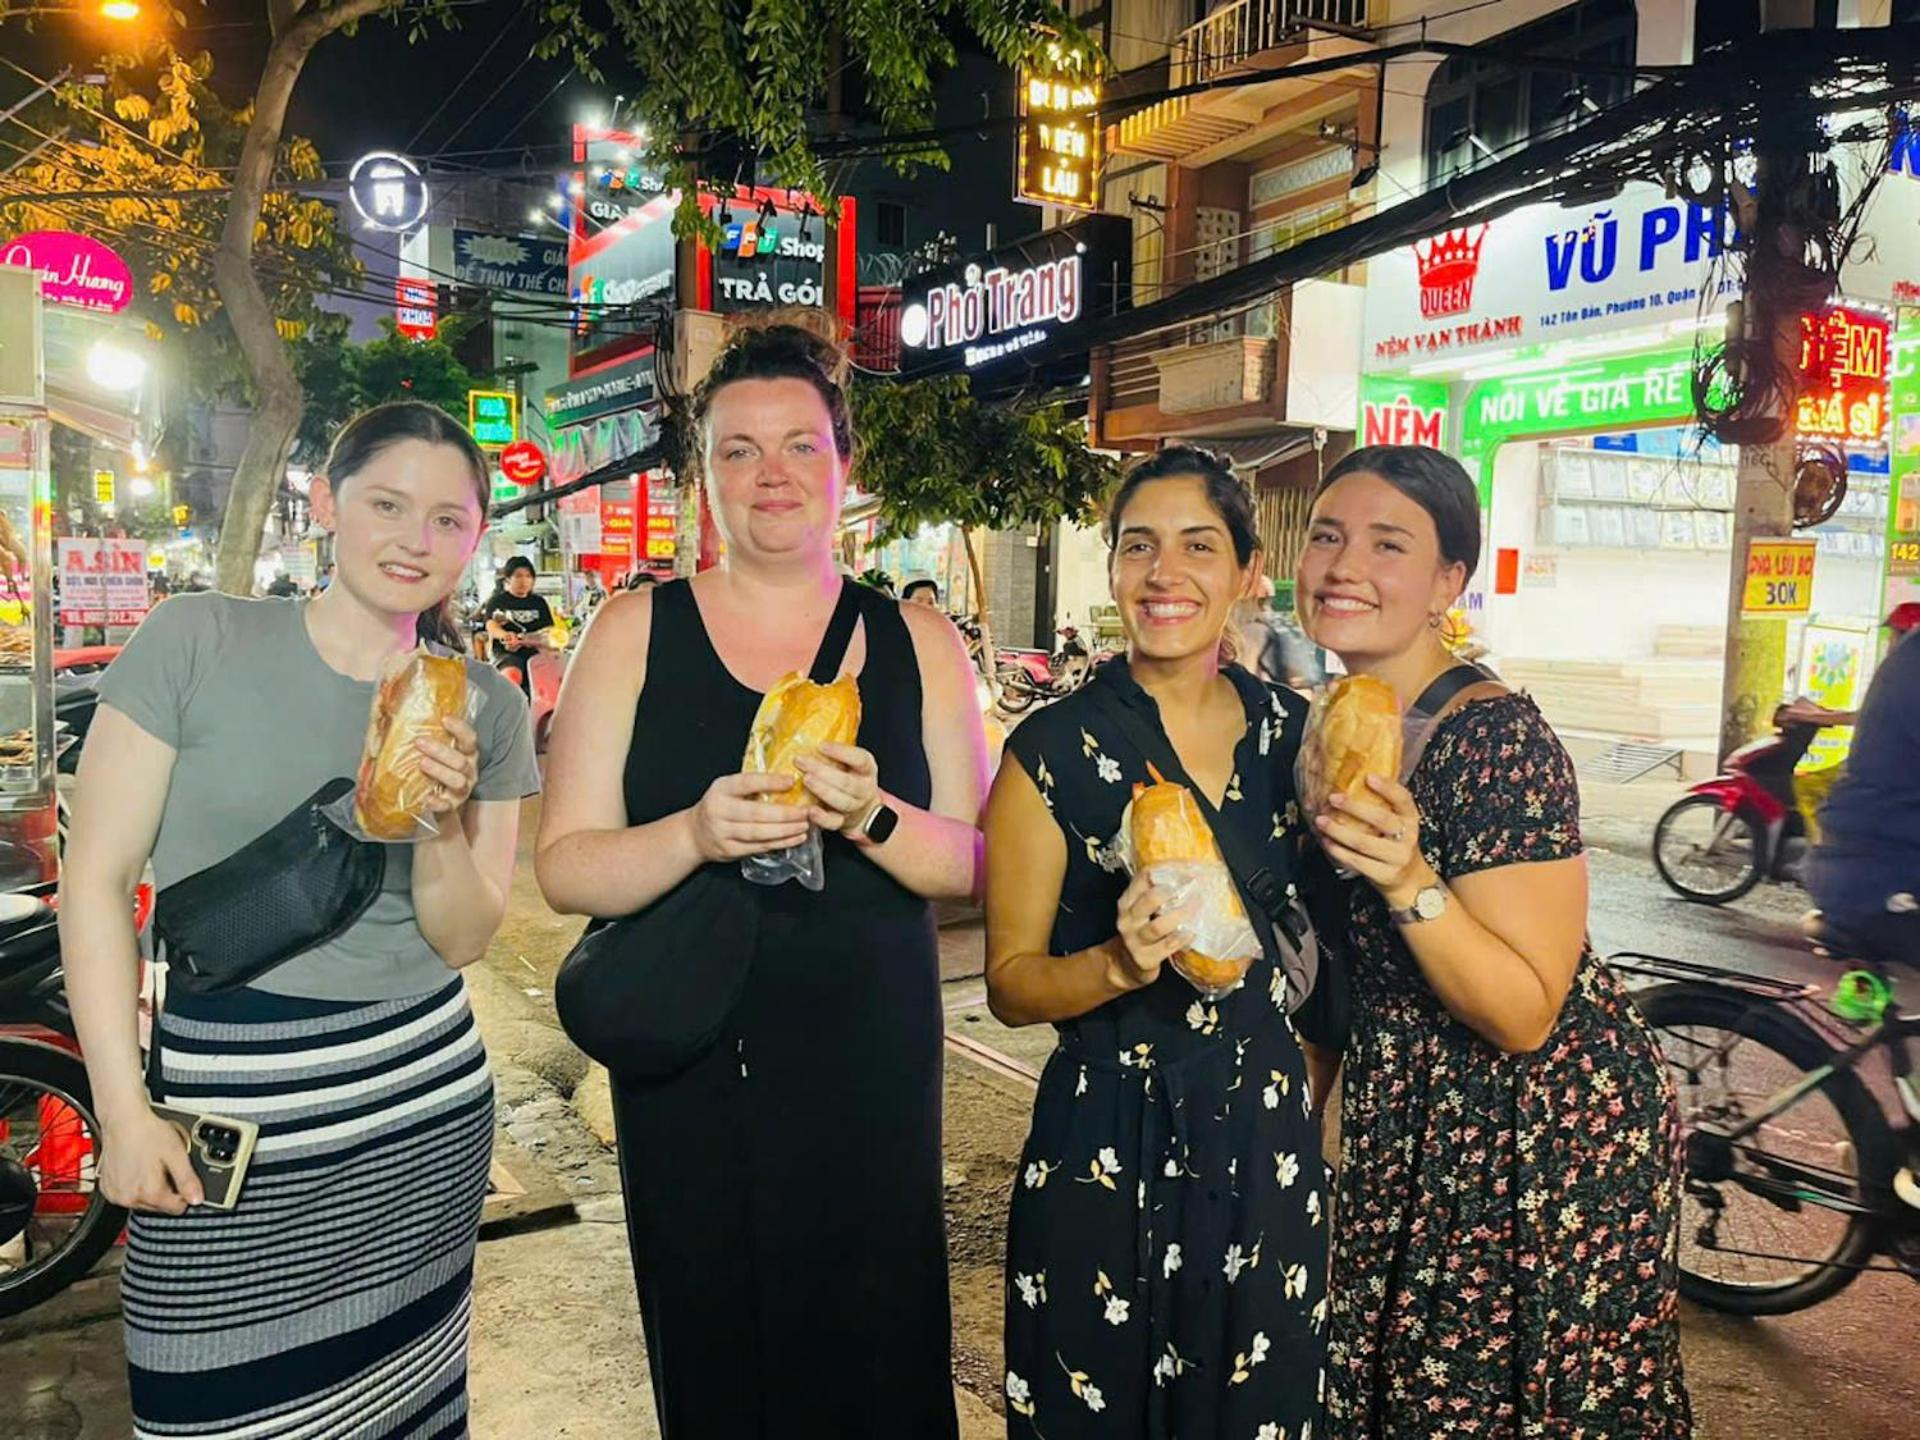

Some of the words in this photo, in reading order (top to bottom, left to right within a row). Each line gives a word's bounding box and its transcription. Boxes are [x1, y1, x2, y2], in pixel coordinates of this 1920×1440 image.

[1545, 209, 1618, 291] VŨ
[1640, 200, 1742, 271] PH
[547, 278, 568, 295] CH
[719, 272, 773, 302] TRẢ
[1420, 277, 1474, 315] QUEEN
[927, 263, 985, 349] Phở
[985, 256, 1081, 334] Trang
[1456, 316, 1522, 345] THÀNH
[1891, 542, 1919, 561] 142
[1765, 581, 1797, 604] 30K
